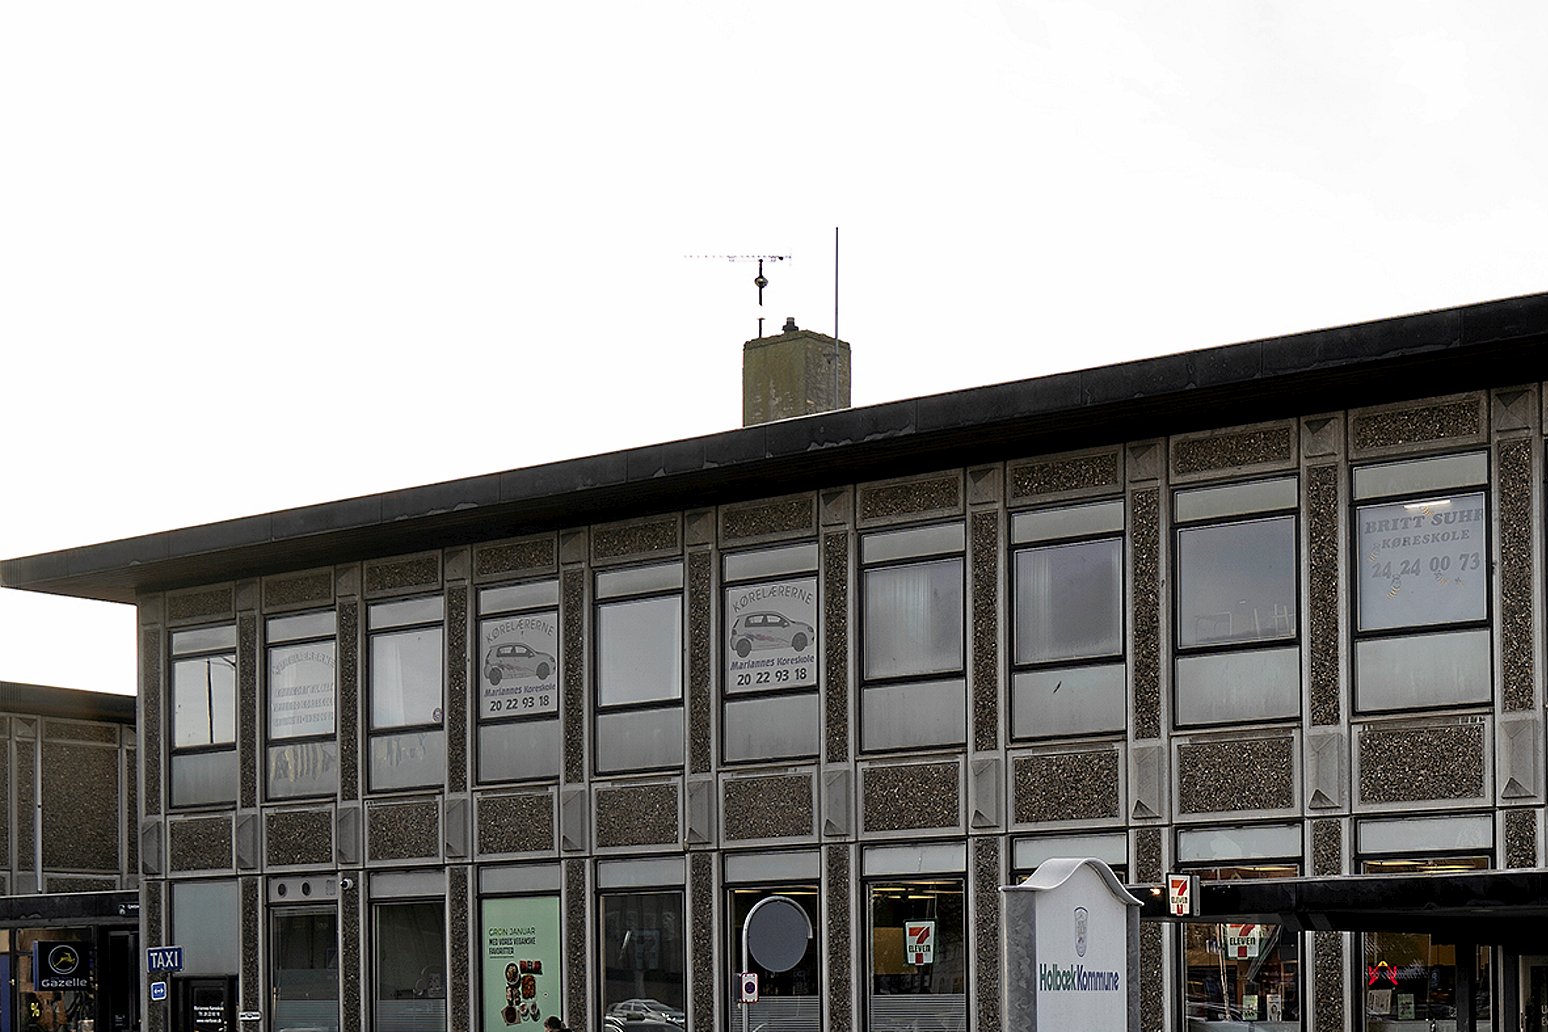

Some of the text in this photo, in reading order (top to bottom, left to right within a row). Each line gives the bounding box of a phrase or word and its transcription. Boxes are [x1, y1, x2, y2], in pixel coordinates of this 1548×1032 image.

[1364, 515, 1425, 534] BRITT
[1381, 529, 1470, 549] KØRESKOLE
[1371, 552, 1480, 579] 24 24 00 73
[732, 585, 814, 612] KØRELÆRERNE
[486, 619, 554, 644] KØRELÆRERNE
[730, 658, 775, 670] Mariannes
[737, 667, 807, 686] 20 22 93 18
[490, 694, 550, 711] 20 22 93 18
[150, 951, 179, 969] TAXI
[41, 977, 88, 988] Gazelle
[1039, 963, 1120, 991] Holbæk Kommune
